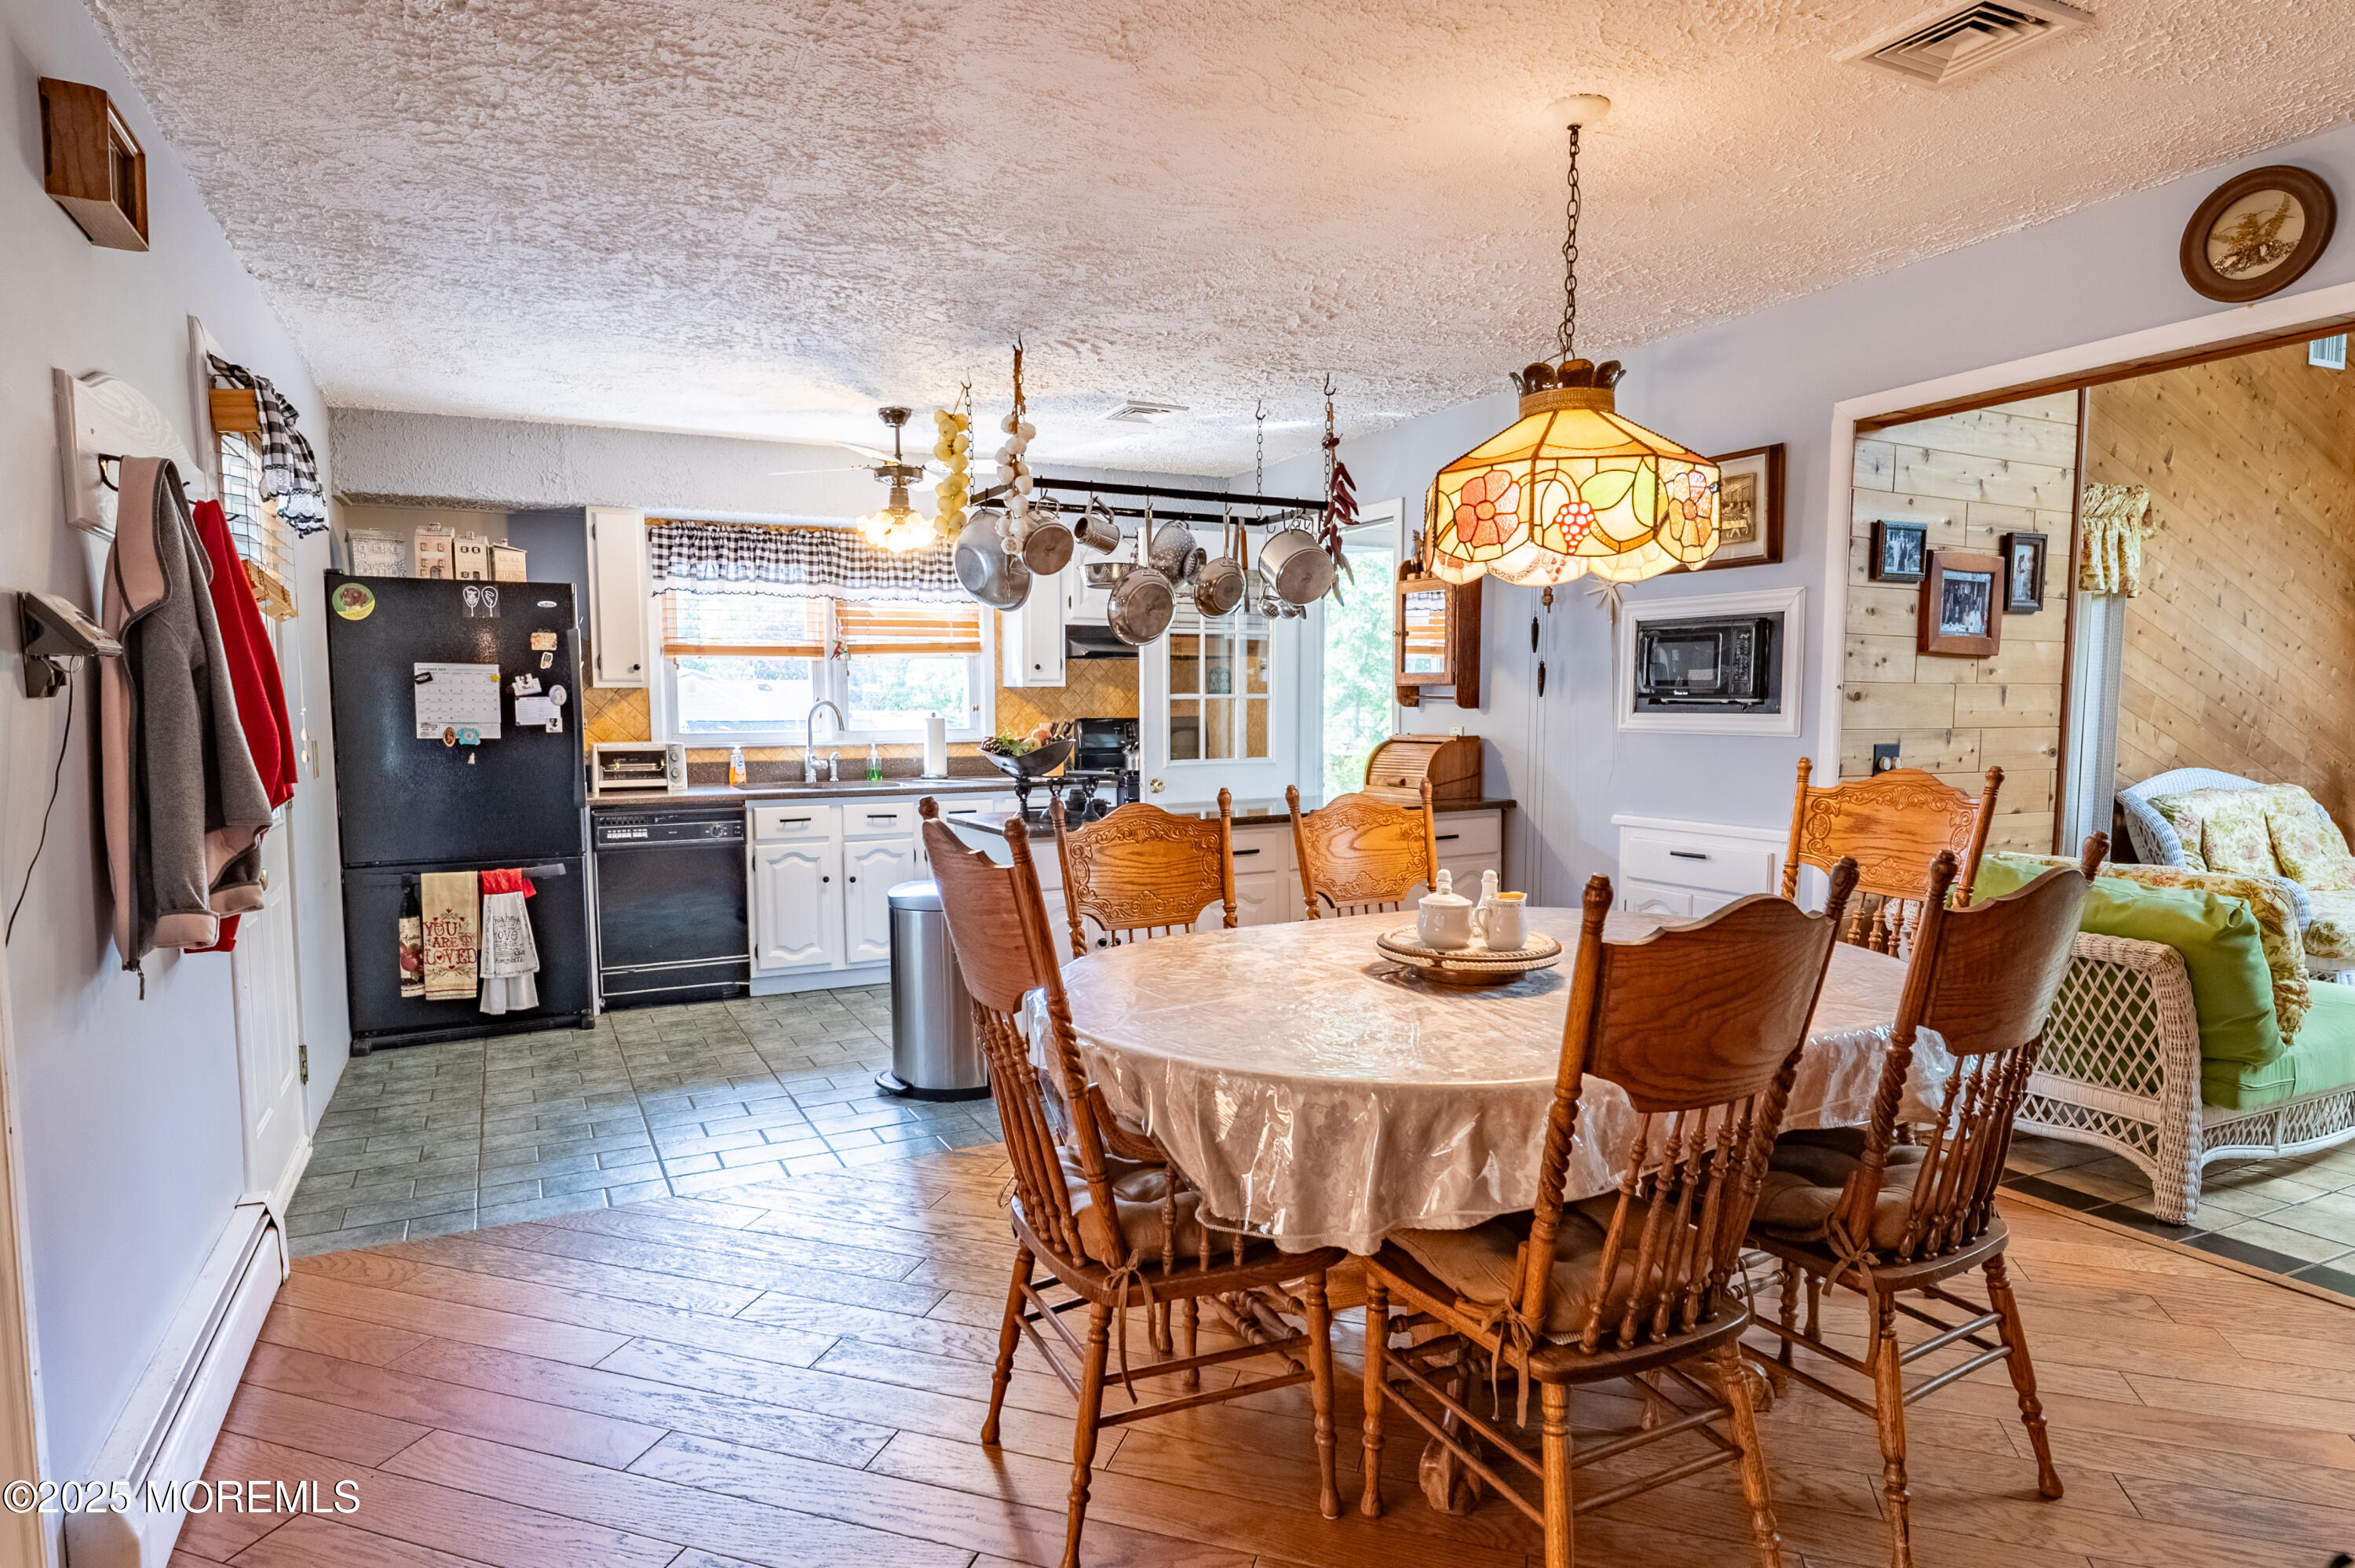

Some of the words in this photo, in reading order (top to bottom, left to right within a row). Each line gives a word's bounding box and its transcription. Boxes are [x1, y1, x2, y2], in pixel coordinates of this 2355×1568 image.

[423, 921, 458, 936] YOU
[432, 937, 458, 948] ARE
[459, 934, 473, 946] SO
[424, 948, 477, 965] LOVED
